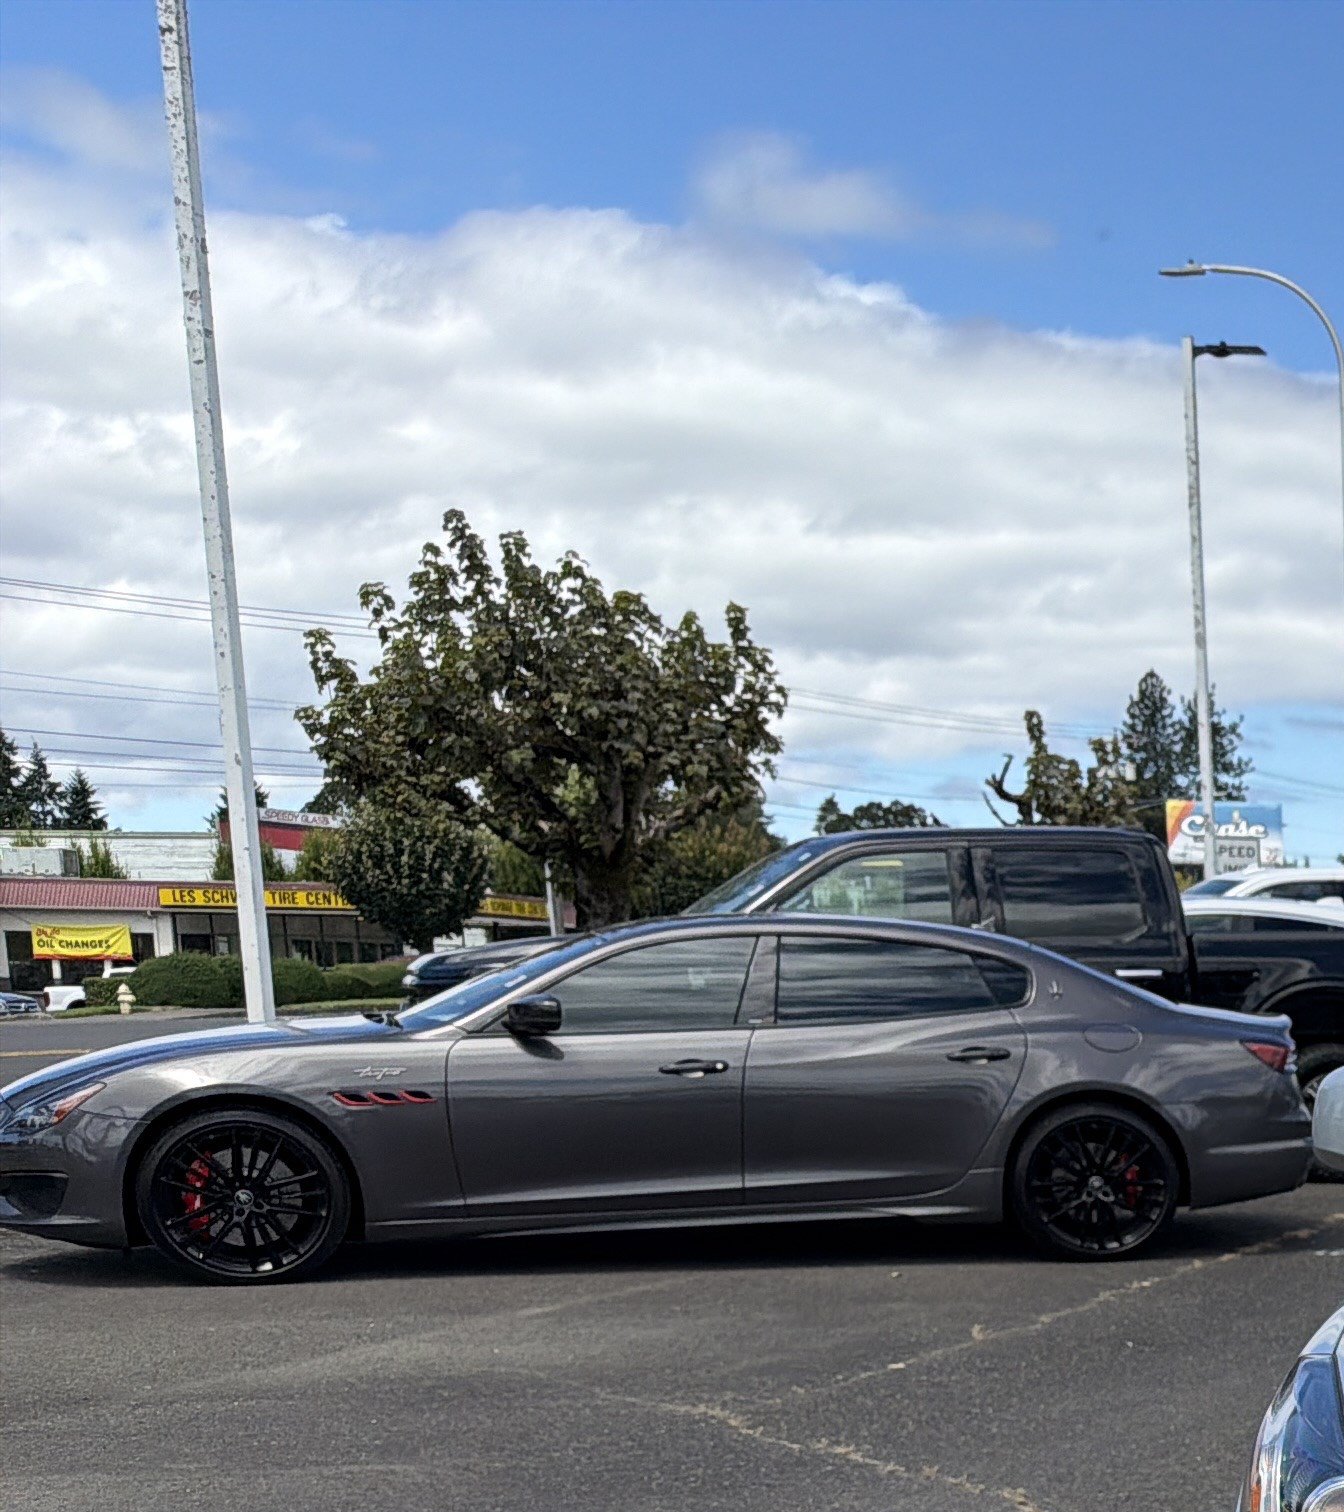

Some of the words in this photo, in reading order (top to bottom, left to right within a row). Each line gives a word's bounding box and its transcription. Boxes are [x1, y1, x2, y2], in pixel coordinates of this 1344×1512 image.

[1219, 845, 1256, 858] PEED
[172, 889, 196, 904] LES
[269, 891, 300, 905] TIRE
[305, 892, 352, 907] CENTE
[37, 938, 55, 949] OIL
[58, 939, 111, 950] CHANGES
